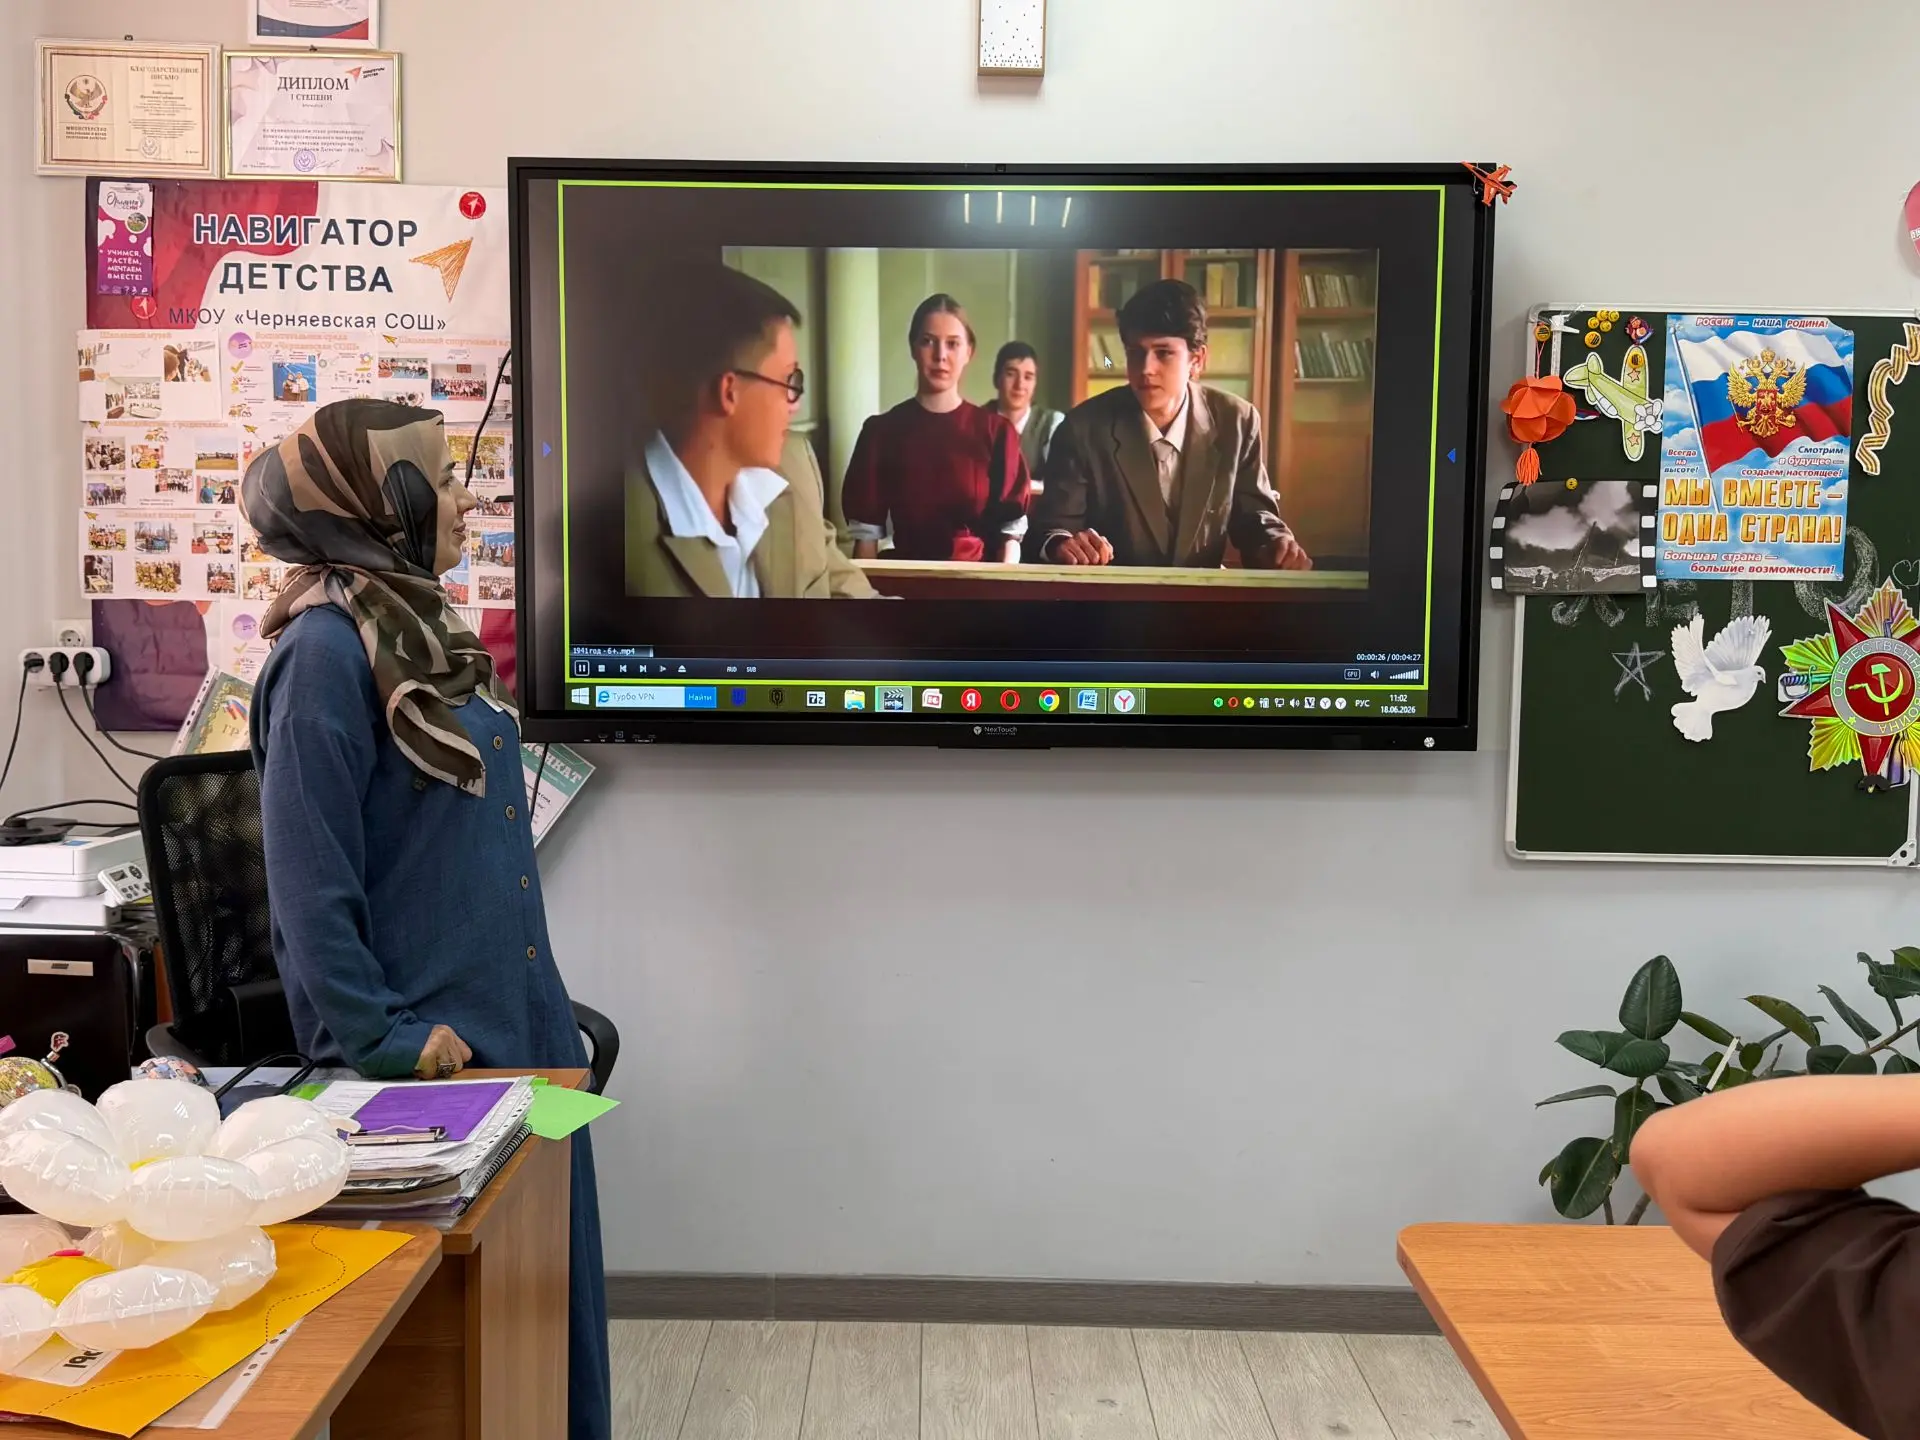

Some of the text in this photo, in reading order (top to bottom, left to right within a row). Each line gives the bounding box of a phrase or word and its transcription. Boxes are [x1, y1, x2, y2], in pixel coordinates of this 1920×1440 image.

[277, 77, 350, 92] ДИПЛОМ
[196, 215, 418, 247] НАВИГАТОР
[107, 249, 142, 258] УЧИМСЯ,
[107, 257, 142, 266] РАСТЁМ,
[107, 265, 143, 273] МЕЧТАЕМ
[107, 273, 143, 281] ВМЕСТЕ!
[219, 262, 394, 294] ДЕТСТВА
[169, 308, 447, 334] МКОУ «Черняевская СОШ»
[1696, 317, 1734, 327] РОССИЯ
[1752, 318, 1782, 328] НАША
[1786, 319, 1829, 329] РОДИНА!
[1667, 449, 1697, 459] Всегда
[1798, 445, 1844, 456] Смотрим
[1788, 455, 1831, 467] будущее
[1664, 466, 1699, 474] высоте!
[1786, 469, 1843, 478] настоящее!
[1664, 478, 1711, 506] МЫ
[1723, 479, 1822, 508] ВМЕСТЕ
[1663, 513, 1842, 546] ОДНА СТРАНА!
[1663, 551, 1718, 561] Большая
[1721, 553, 1762, 563] страна
[1690, 562, 1835, 574] большие возможности!
[573, 647, 589, 655] 1941
[590, 648, 602, 656] год
[1356, 653, 1386, 661] 00:00:26
[1391, 654, 1422, 662] 00:04:27
[1347, 670, 1358, 678] GPU
[612, 692, 655, 702] Турбо VPN
[688, 693, 713, 702] Найти
[1390, 694, 1408, 703] 11:02
[1355, 699, 1370, 708] РУС
[1380, 705, 1416, 715] 18.06.2026
[984, 726, 1018, 734] NexTouch
